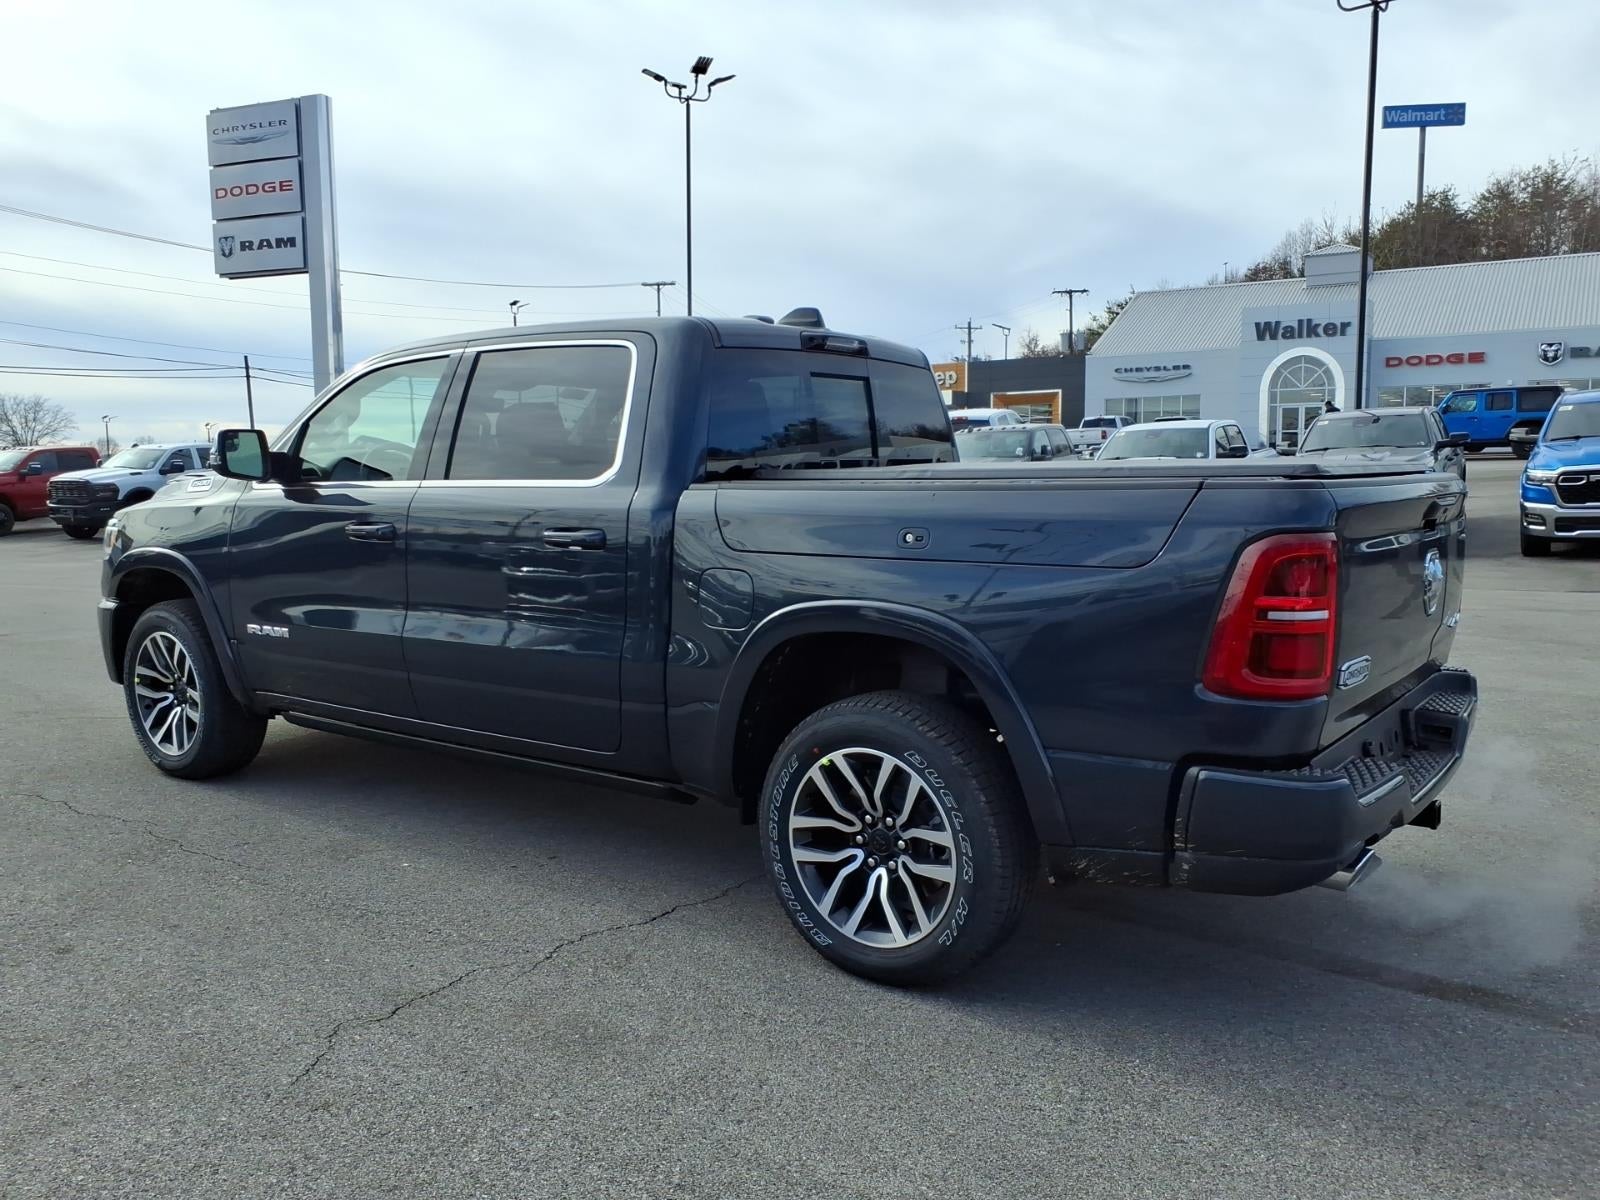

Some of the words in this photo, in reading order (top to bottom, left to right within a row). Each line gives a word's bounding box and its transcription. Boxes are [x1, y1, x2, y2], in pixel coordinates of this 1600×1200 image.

[1385, 108, 1446, 122] Walmart
[212, 119, 288, 135] CHRYSLER
[215, 179, 294, 199] DODGE
[239, 236, 296, 252] RAM
[1255, 319, 1352, 341] Walker
[1385, 351, 1486, 368] DODGE
[1114, 363, 1191, 374] CHRYSLER
[247, 624, 290, 639] RAM
[904, 750, 973, 884] DUELER
[768, 753, 832, 947] BRIDGESTONE
